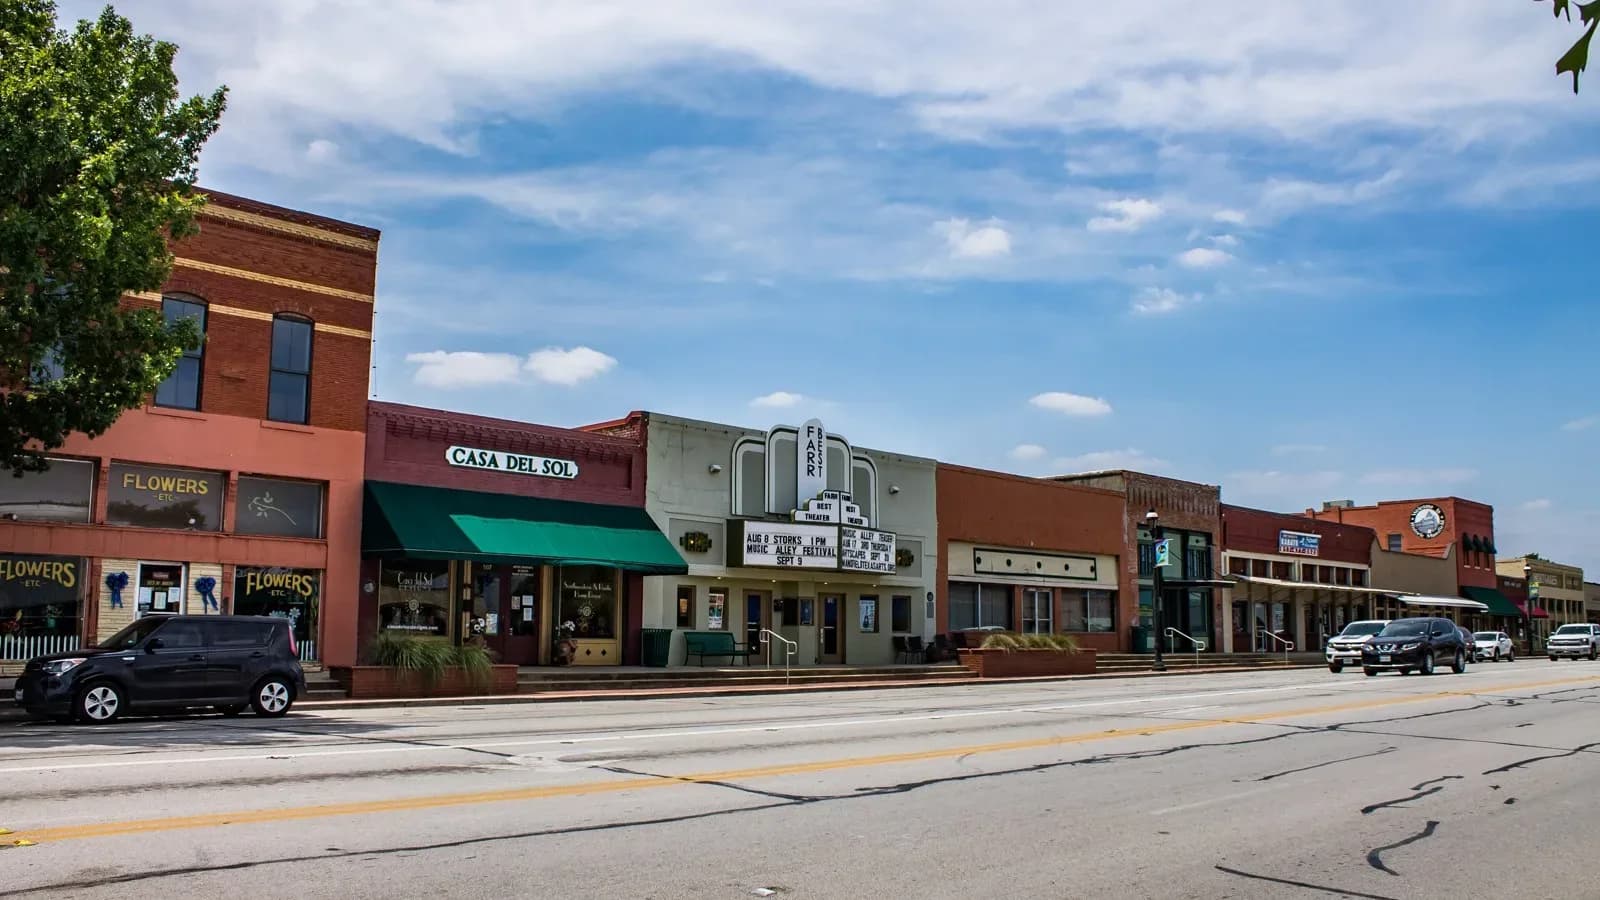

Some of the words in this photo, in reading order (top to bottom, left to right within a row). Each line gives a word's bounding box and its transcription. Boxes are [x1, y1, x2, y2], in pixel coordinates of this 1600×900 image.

[806, 426, 816, 477] FARR
[452, 448, 499, 468] CASA
[506, 455, 538, 473] DEL
[542, 459, 573, 477] SOL
[123, 473, 209, 495] FLOWERS
[805, 513, 830, 521] THEATER
[747, 534, 762, 543] AUG
[764, 535, 769, 543] 8
[773, 535, 802, 545] STORKS
[860, 531, 874, 540] ALLEY
[747, 544, 768, 554] MUSIC
[775, 545, 797, 555] ALLEY
[803, 546, 836, 557] FESTIVAL
[777, 556, 794, 565] SEPT
[797, 557, 803, 565] 9
[0, 559, 75, 588] FLOWERS
[246, 572, 313, 597] FLOWERS
